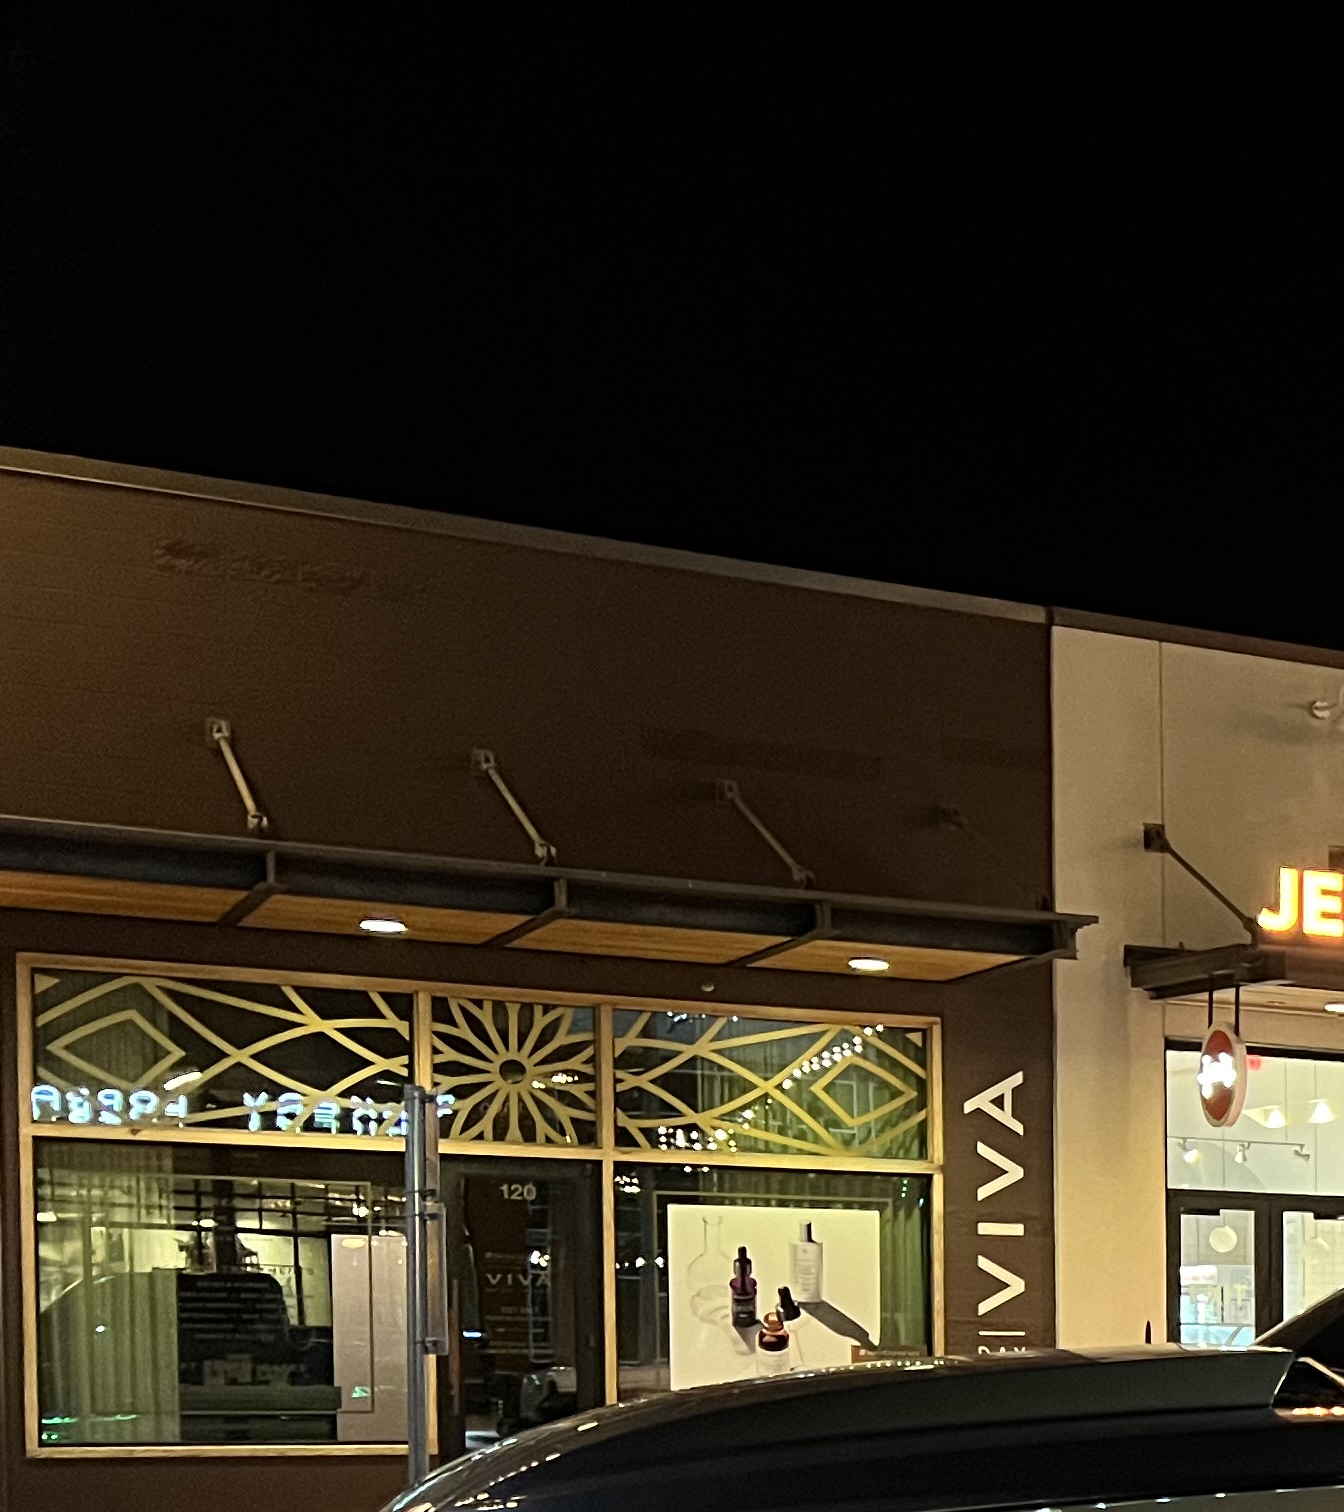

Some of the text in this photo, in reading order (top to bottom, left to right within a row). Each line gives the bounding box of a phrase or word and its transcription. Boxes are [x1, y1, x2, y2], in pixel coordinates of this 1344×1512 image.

[499, 1183, 537, 1201] 120
[963, 1070, 1025, 1316] VIVA
[486, 1272, 551, 1288] VIVA
